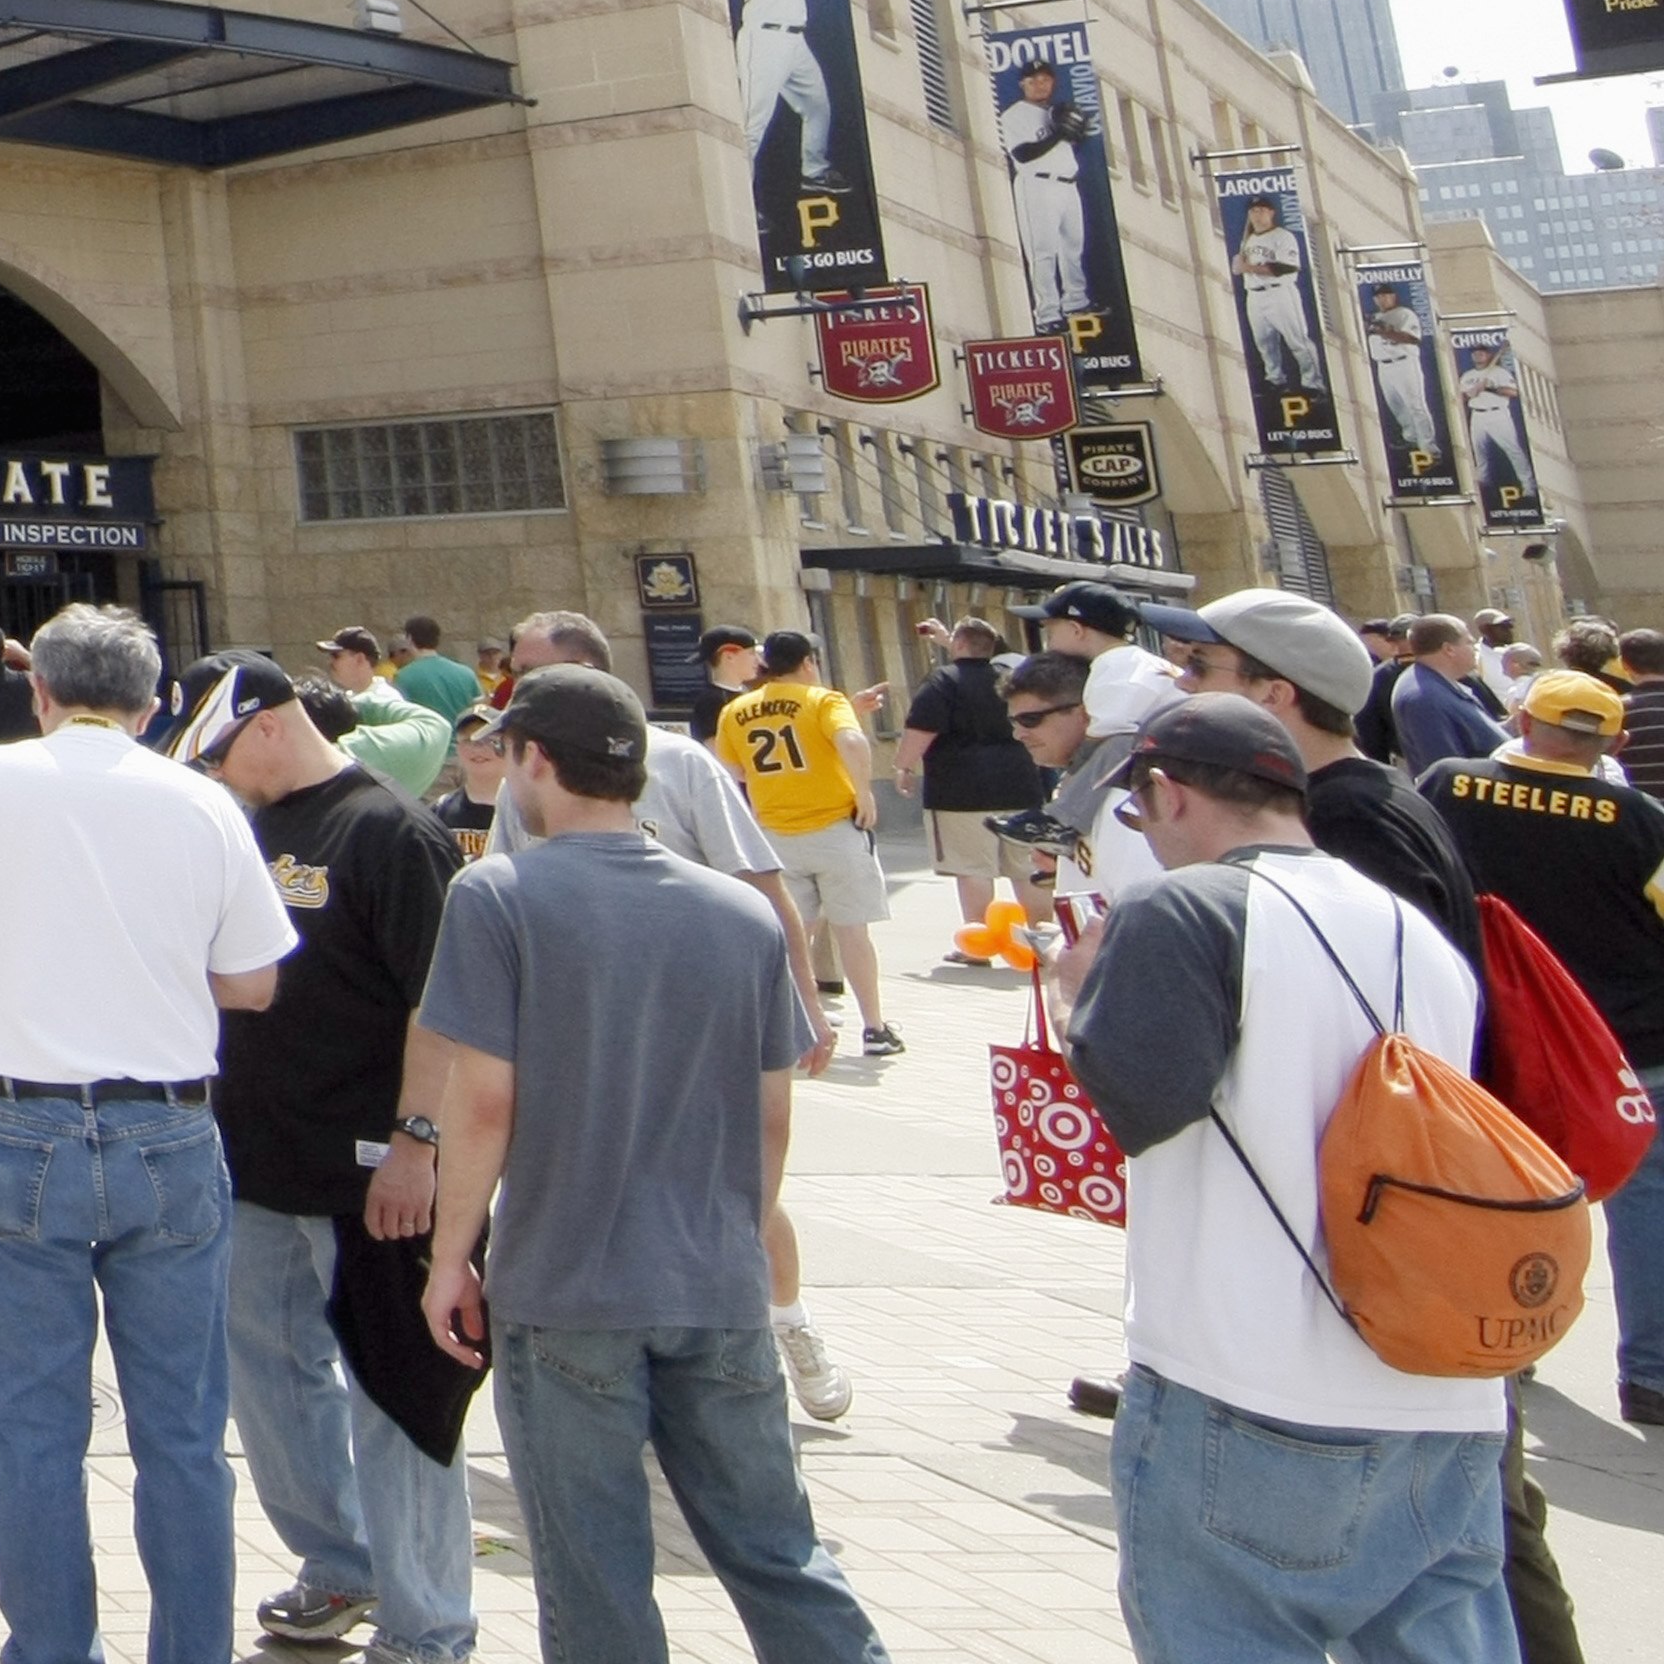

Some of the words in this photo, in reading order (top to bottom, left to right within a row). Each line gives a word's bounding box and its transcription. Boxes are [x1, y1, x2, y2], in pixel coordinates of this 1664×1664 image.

[989, 30, 1092, 74] DOTEL
[1219, 174, 1297, 197] LAROCHE
[797, 195, 840, 248] P
[814, 252, 834, 267] GO
[836, 249, 874, 266] BUCS
[1354, 267, 1423, 285] DONNELLY
[1067, 312, 1103, 354] P
[839, 336, 913, 366] PIRATES
[973, 348, 1062, 376] TICKETS
[1101, 354, 1132, 369] BUCS
[989, 381, 1055, 408] PIRATES
[1280, 396, 1310, 428] P
[1081, 443, 1137, 455] PIRATE
[1091, 458, 1132, 474] CAP
[1081, 474, 1145, 487] COMPANY
[3, 523, 138, 546] INSPECTION
[963, 493, 1072, 560] TICKET
[1090, 517, 1164, 570] SALES
[735, 700, 803, 726] CLEMENTE
[746, 724, 805, 773] 21
[1452, 773, 1617, 824] STEELERS
